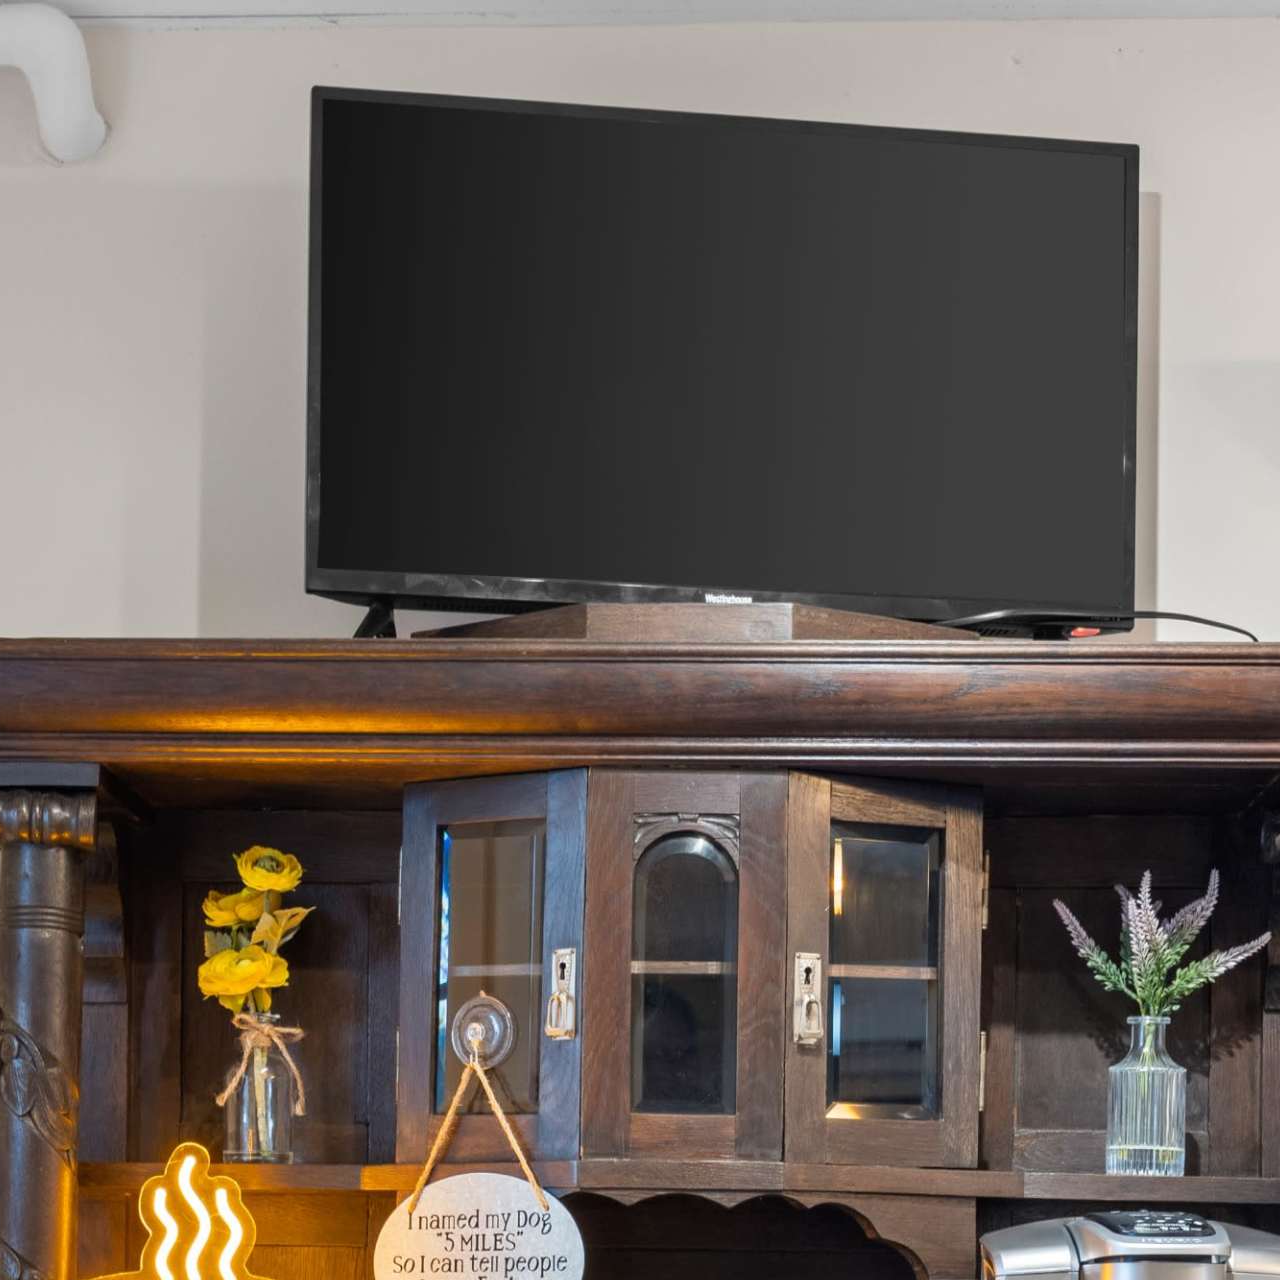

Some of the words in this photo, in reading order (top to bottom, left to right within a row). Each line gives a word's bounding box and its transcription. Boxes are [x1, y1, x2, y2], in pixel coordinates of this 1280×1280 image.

[408, 1212, 413, 1230] I
[418, 1210, 480, 1230] named
[486, 1211, 512, 1231] my
[517, 1211, 552, 1234] Dog
[392, 1256, 416, 1273] So
[420, 1256, 425, 1273] I
[430, 1257, 464, 1273] can
[471, 1254, 499, 1273] tell
[504, 1255, 568, 1278] people
